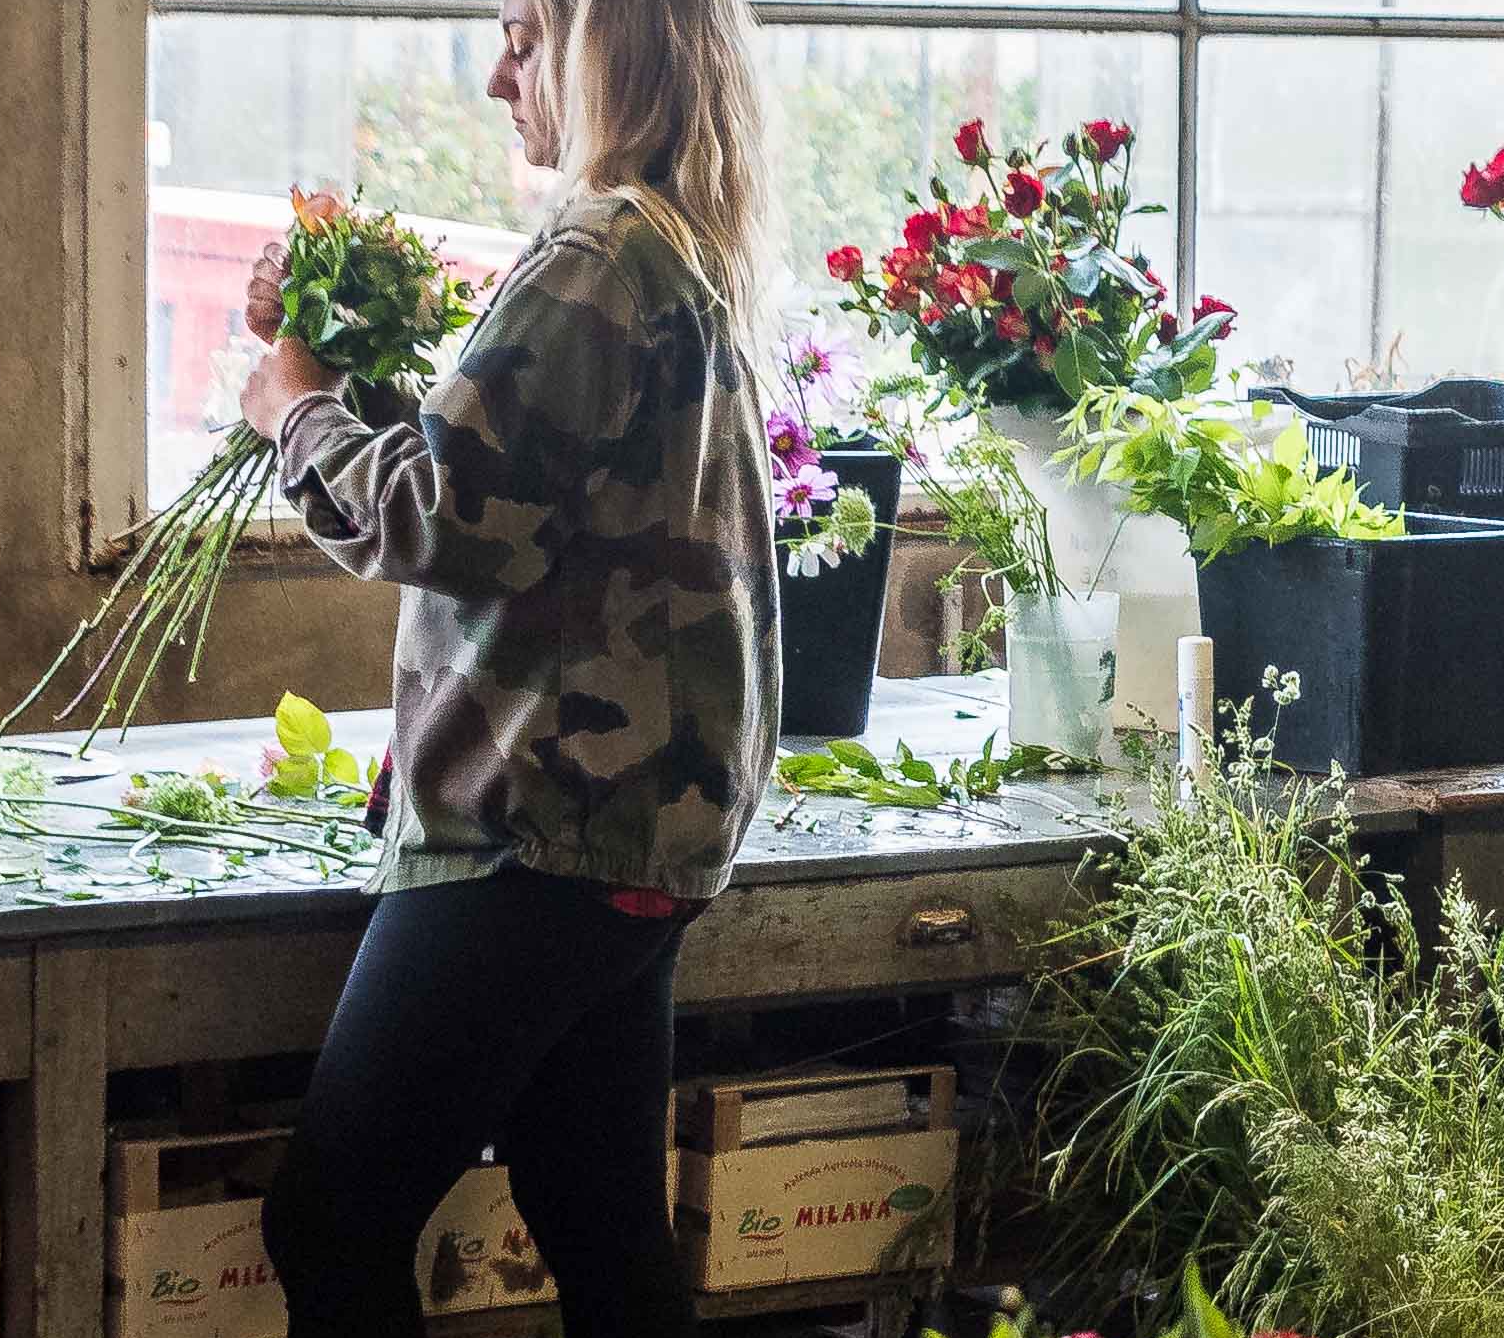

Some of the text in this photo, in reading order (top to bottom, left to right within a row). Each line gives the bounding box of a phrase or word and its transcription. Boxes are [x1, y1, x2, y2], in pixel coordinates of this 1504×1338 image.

[737, 1207, 781, 1234] Bio
[794, 1197, 892, 1228] MILANA
[150, 1270, 201, 1299] Bio
